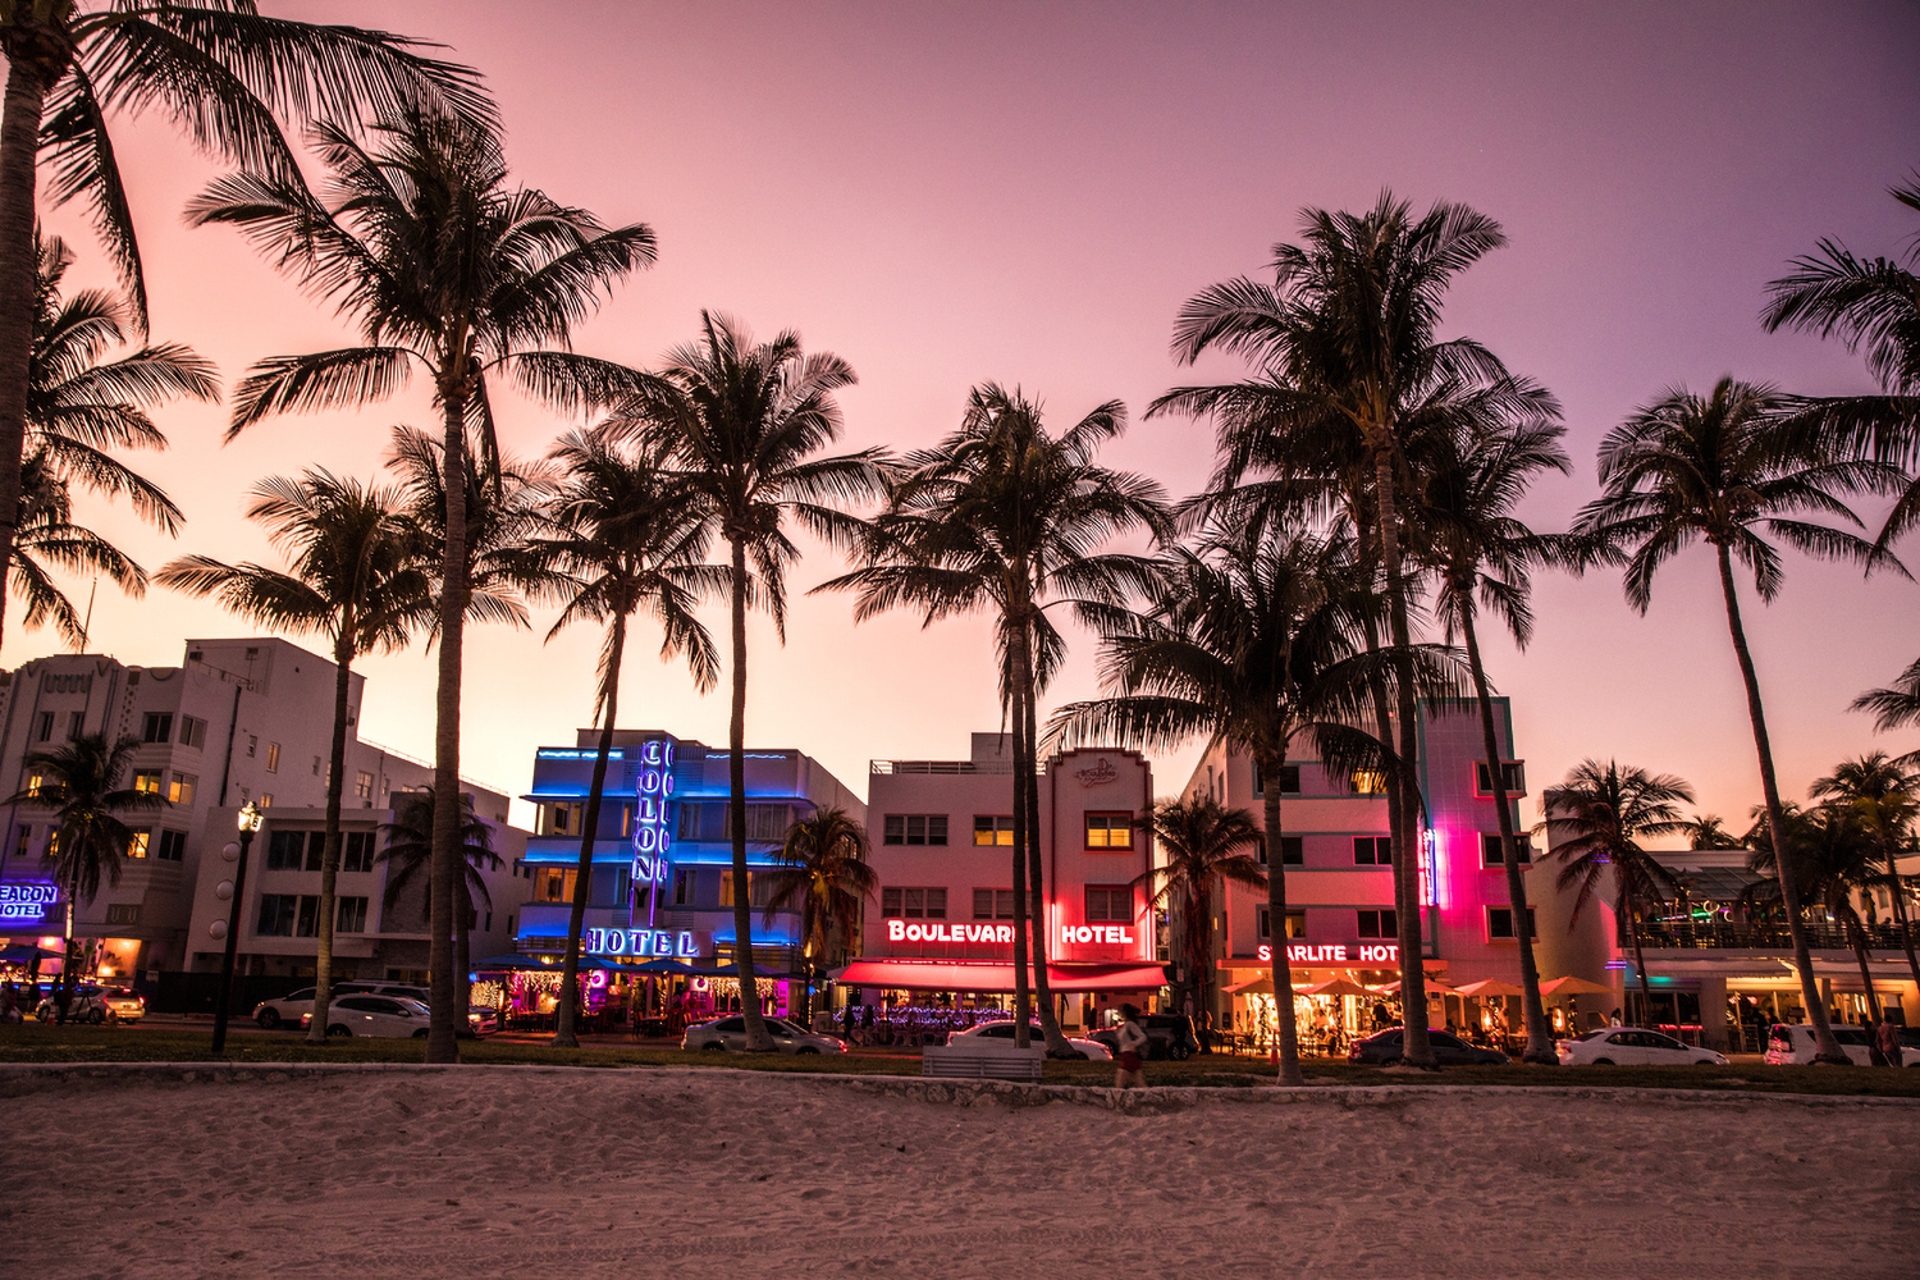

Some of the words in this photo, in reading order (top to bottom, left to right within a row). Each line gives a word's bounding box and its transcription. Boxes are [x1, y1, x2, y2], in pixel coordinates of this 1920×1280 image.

[634, 740, 661, 908] COLONY
[0, 886, 57, 902] EACON
[0, 903, 45, 918] OTEL
[586, 928, 699, 956] HOTEL
[1062, 926, 1134, 943] HOTEL
[1258, 945, 1346, 961] SARLITE
[1360, 945, 1398, 961] HOT
